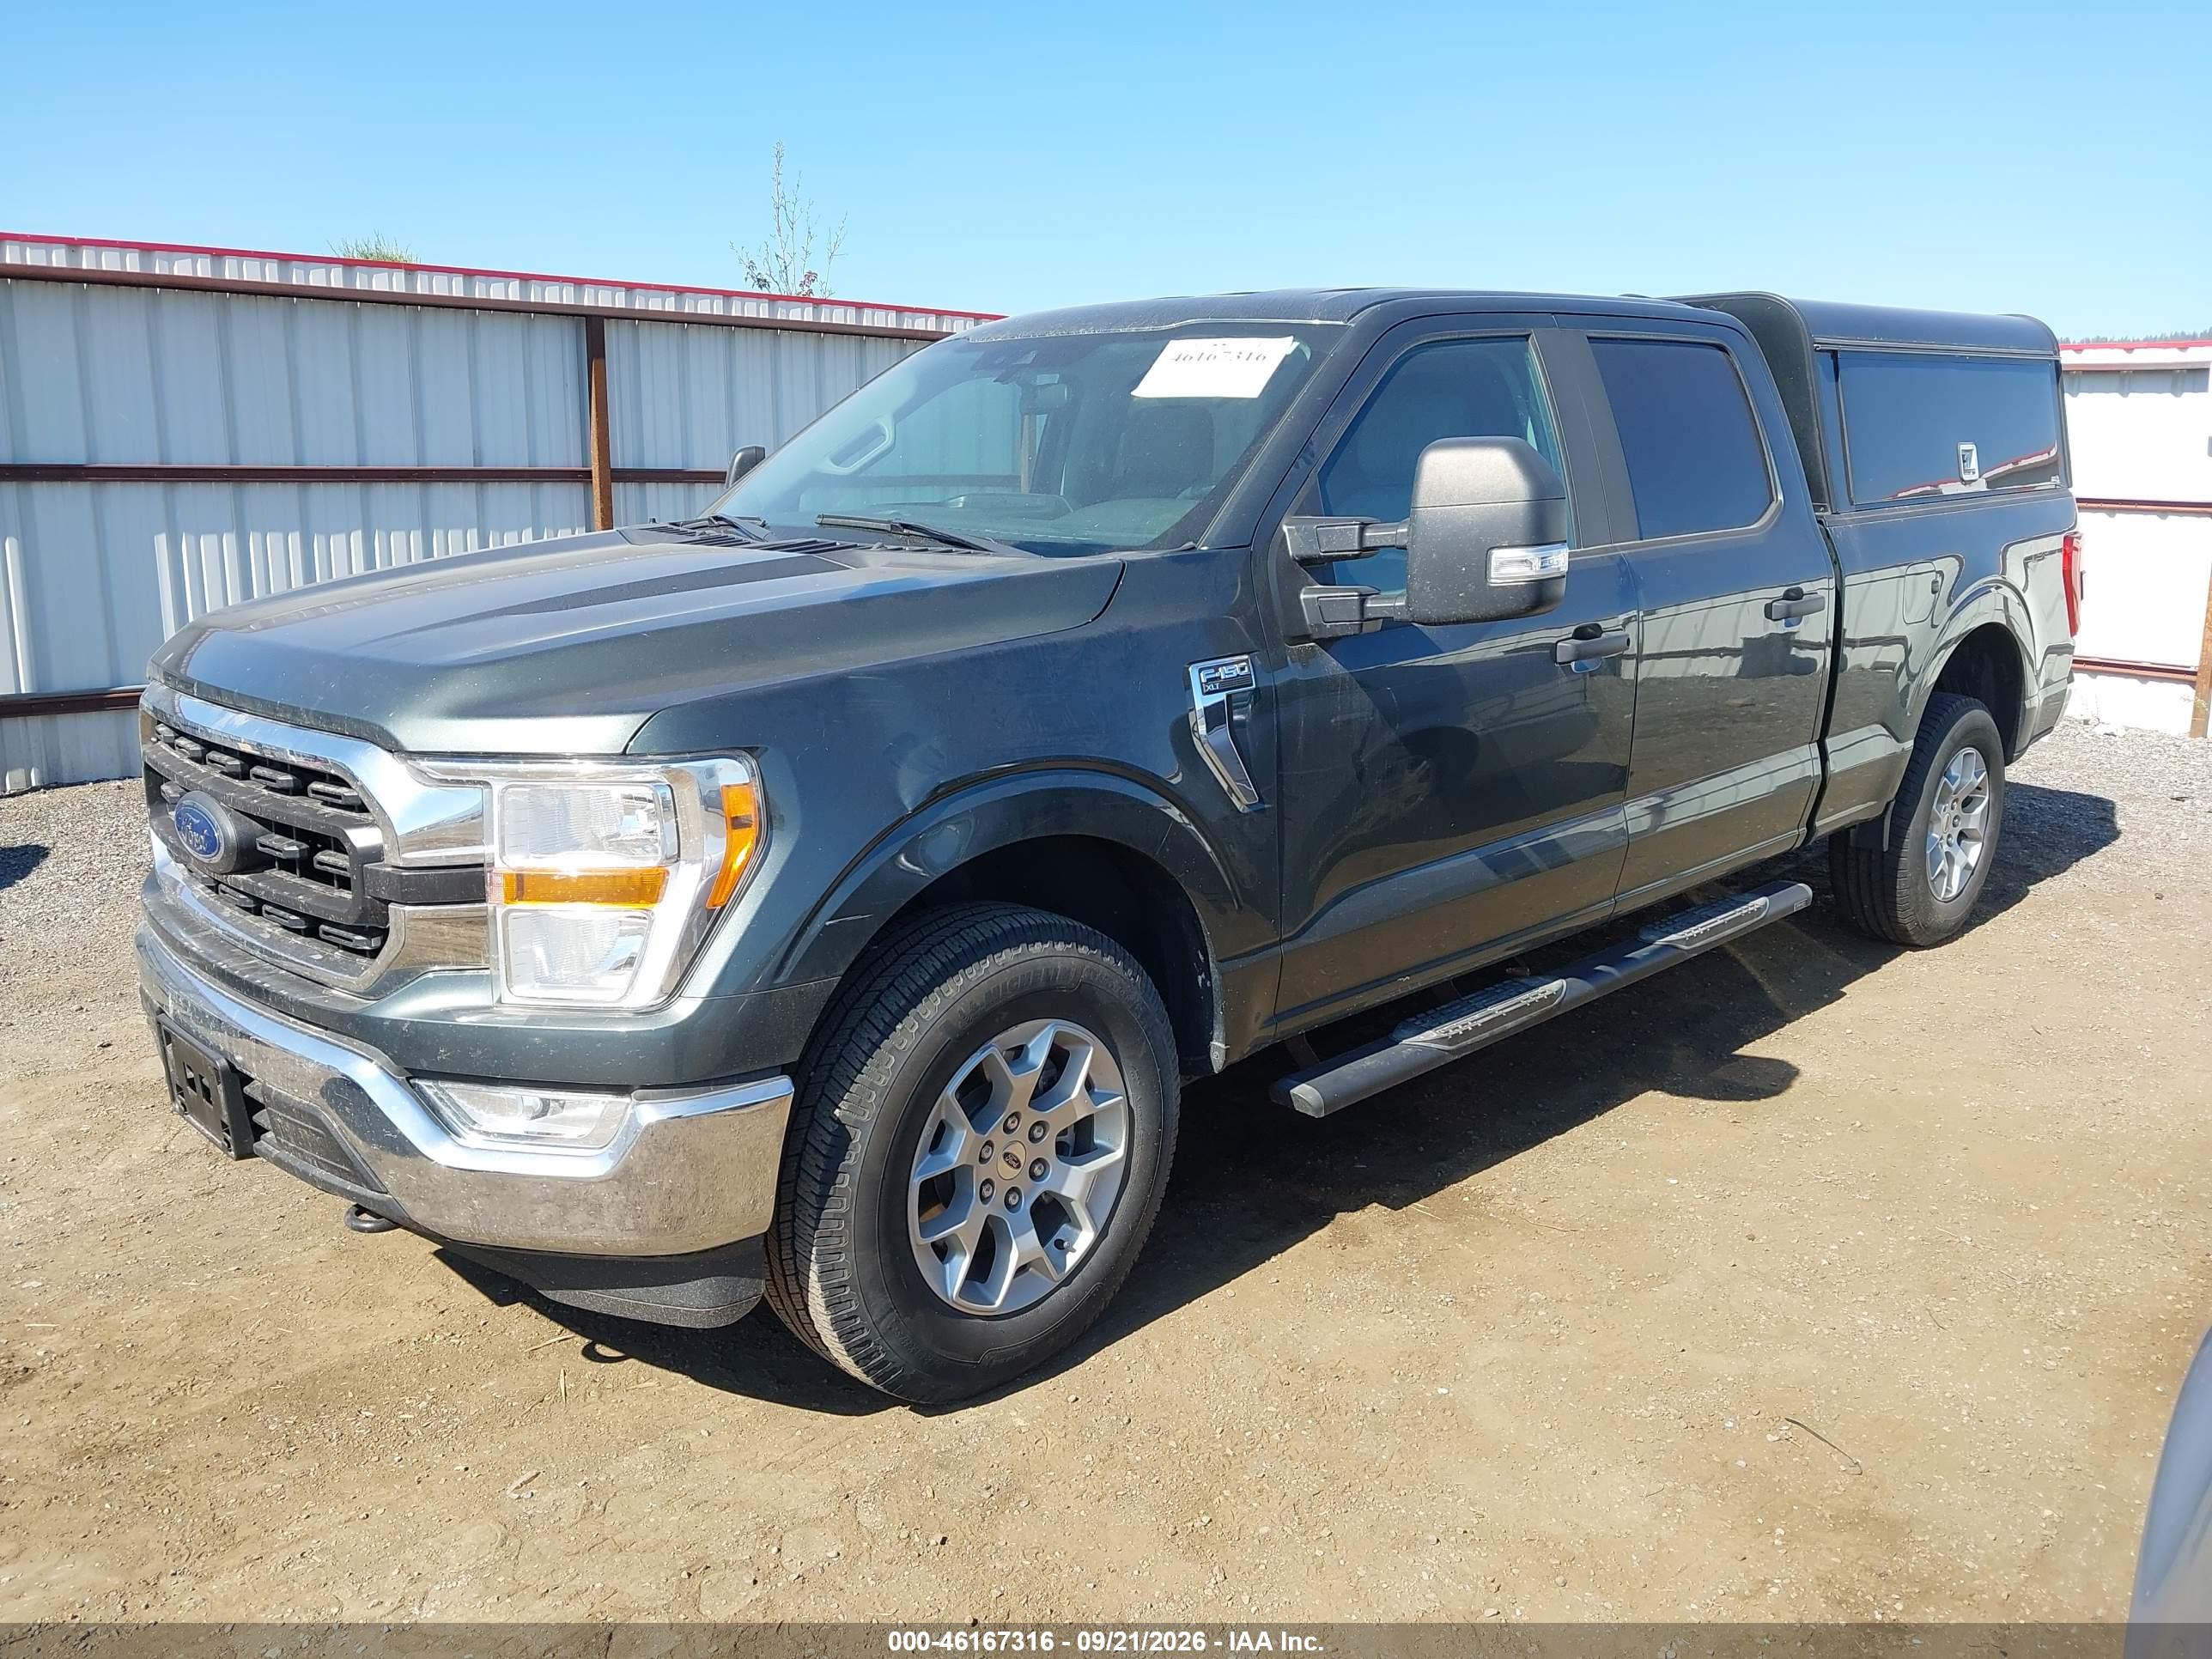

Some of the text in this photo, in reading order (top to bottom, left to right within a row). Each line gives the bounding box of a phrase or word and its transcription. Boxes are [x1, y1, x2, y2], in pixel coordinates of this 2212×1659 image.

[1200, 662, 1249, 683] F-150
[1205, 683, 1220, 692] XLT
[1005, 1154, 1019, 1168] Ford
